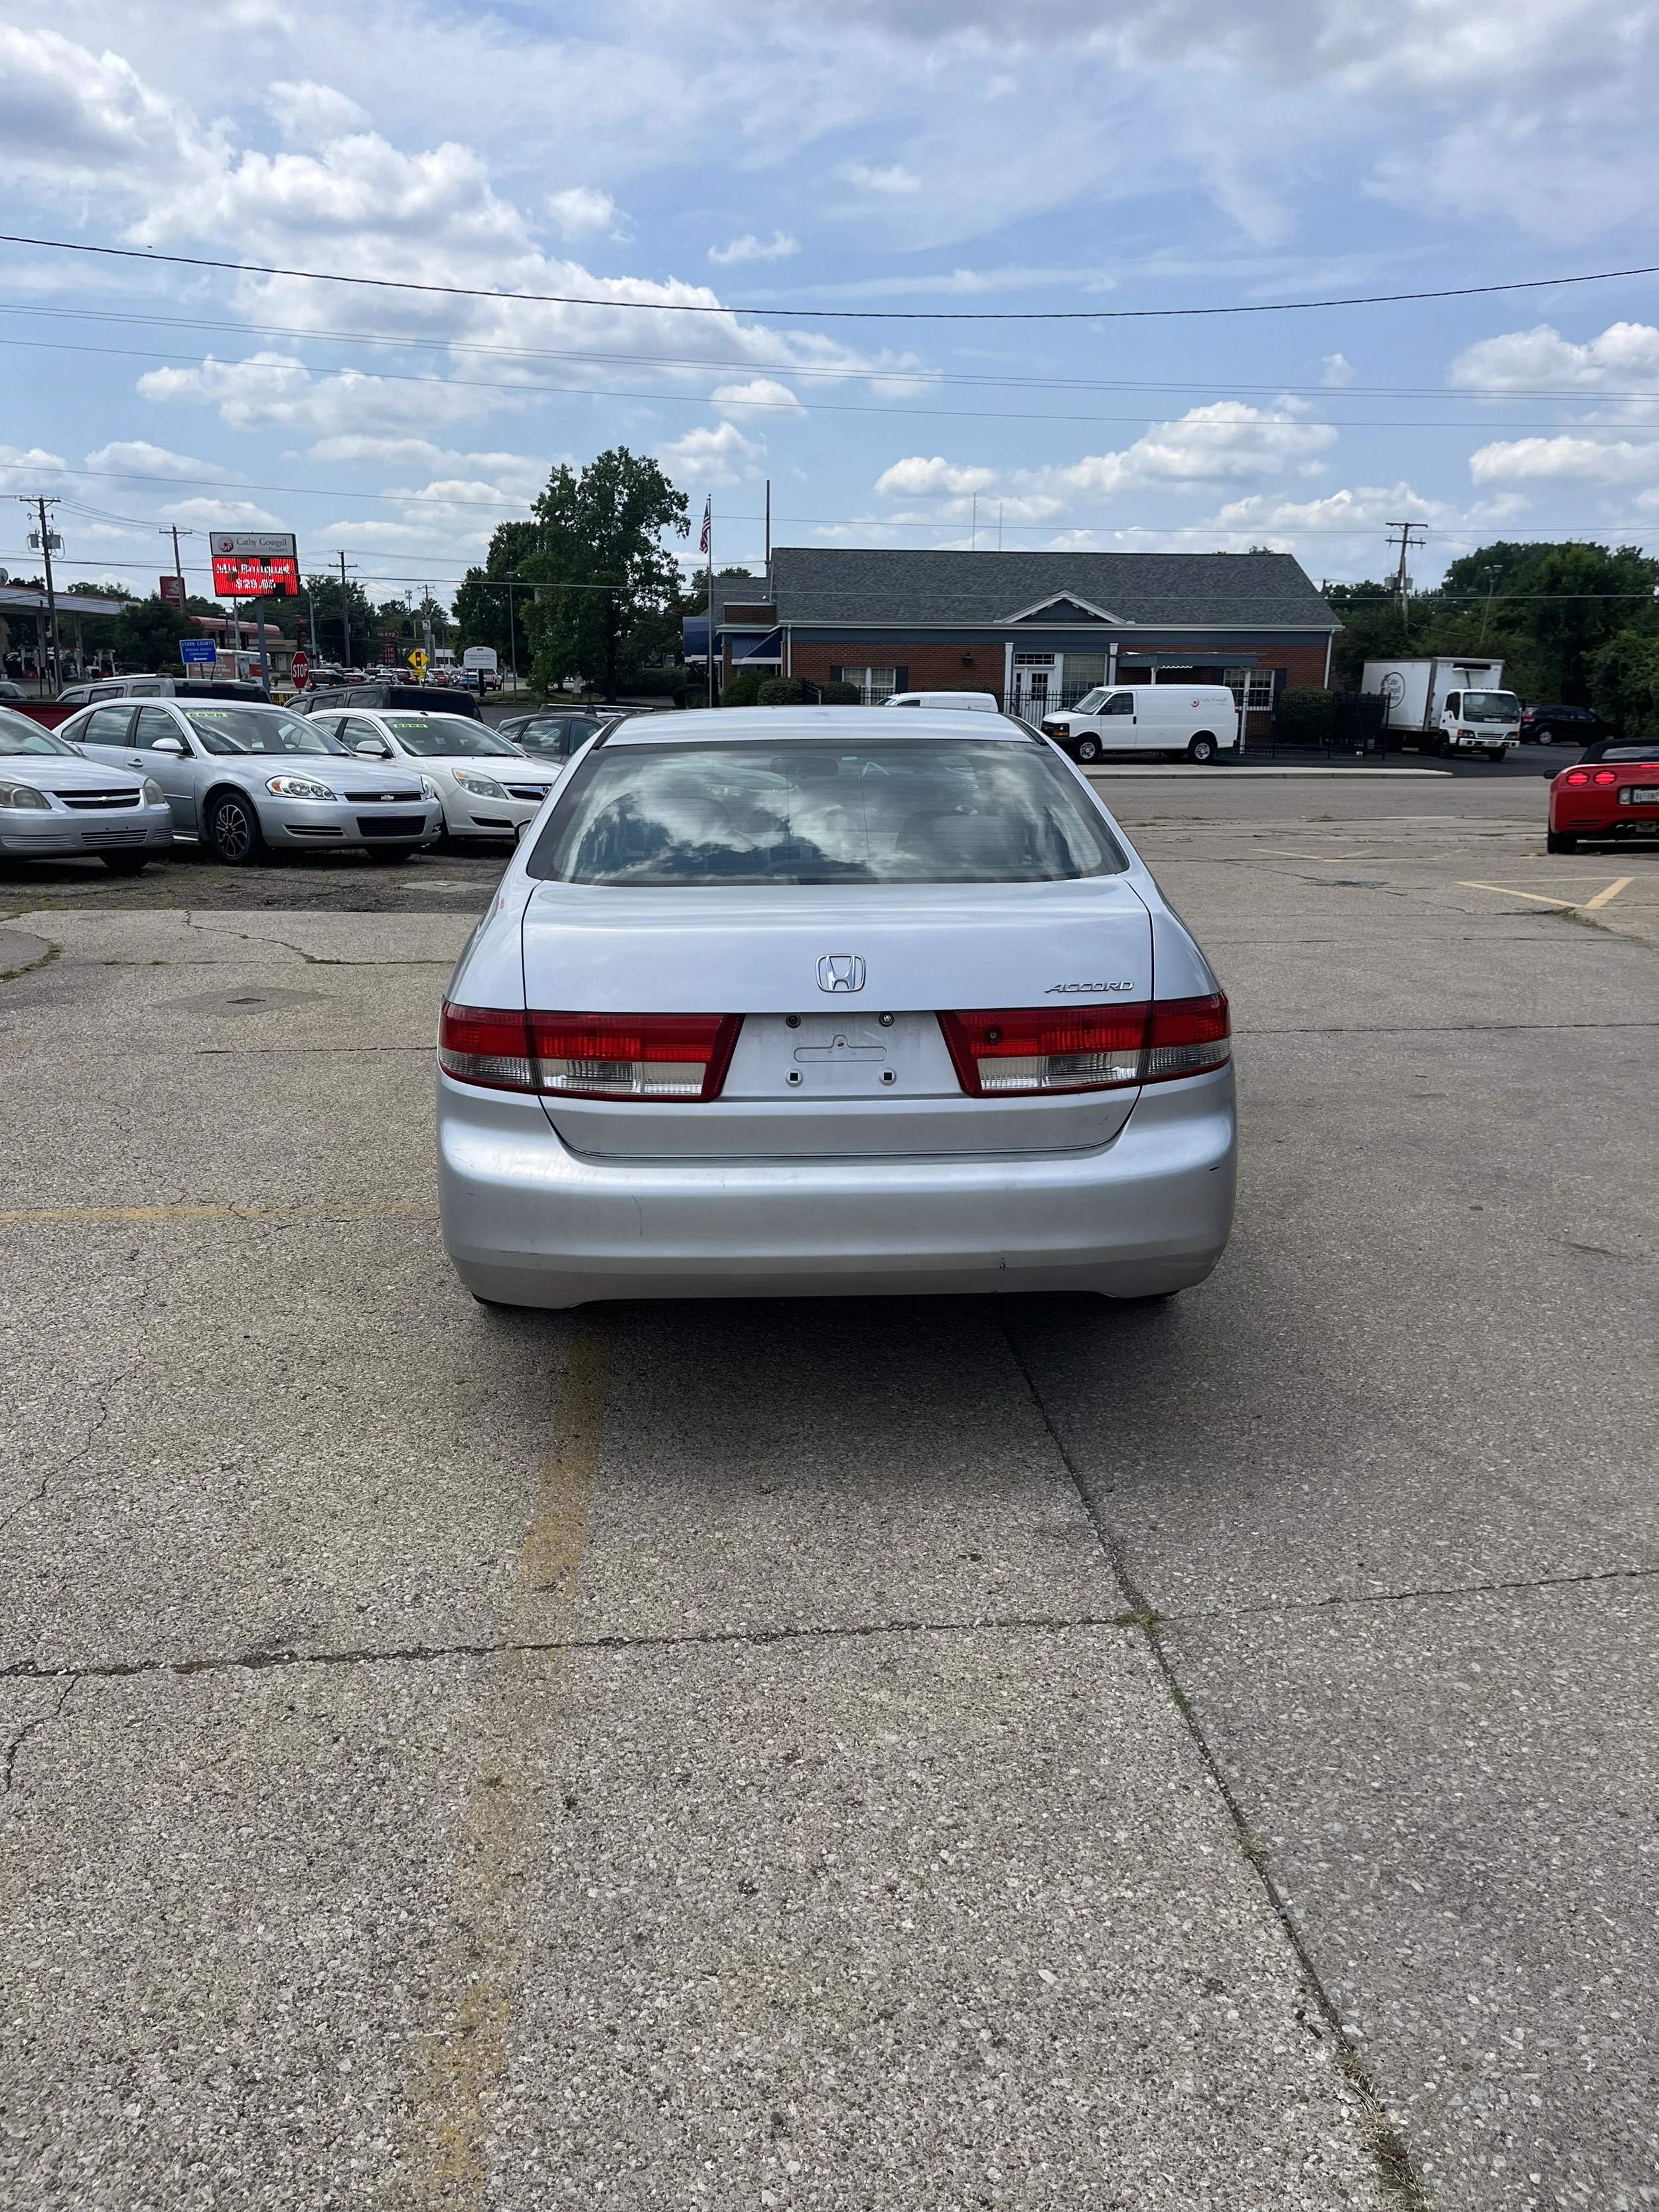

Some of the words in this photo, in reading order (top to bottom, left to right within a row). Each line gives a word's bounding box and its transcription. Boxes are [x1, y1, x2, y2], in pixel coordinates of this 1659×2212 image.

[236, 538, 257, 548] Cathy
[259, 538, 287, 548] Cowgill
[293, 664, 308, 677] STOP
[1045, 981, 1134, 993] ACCORD
